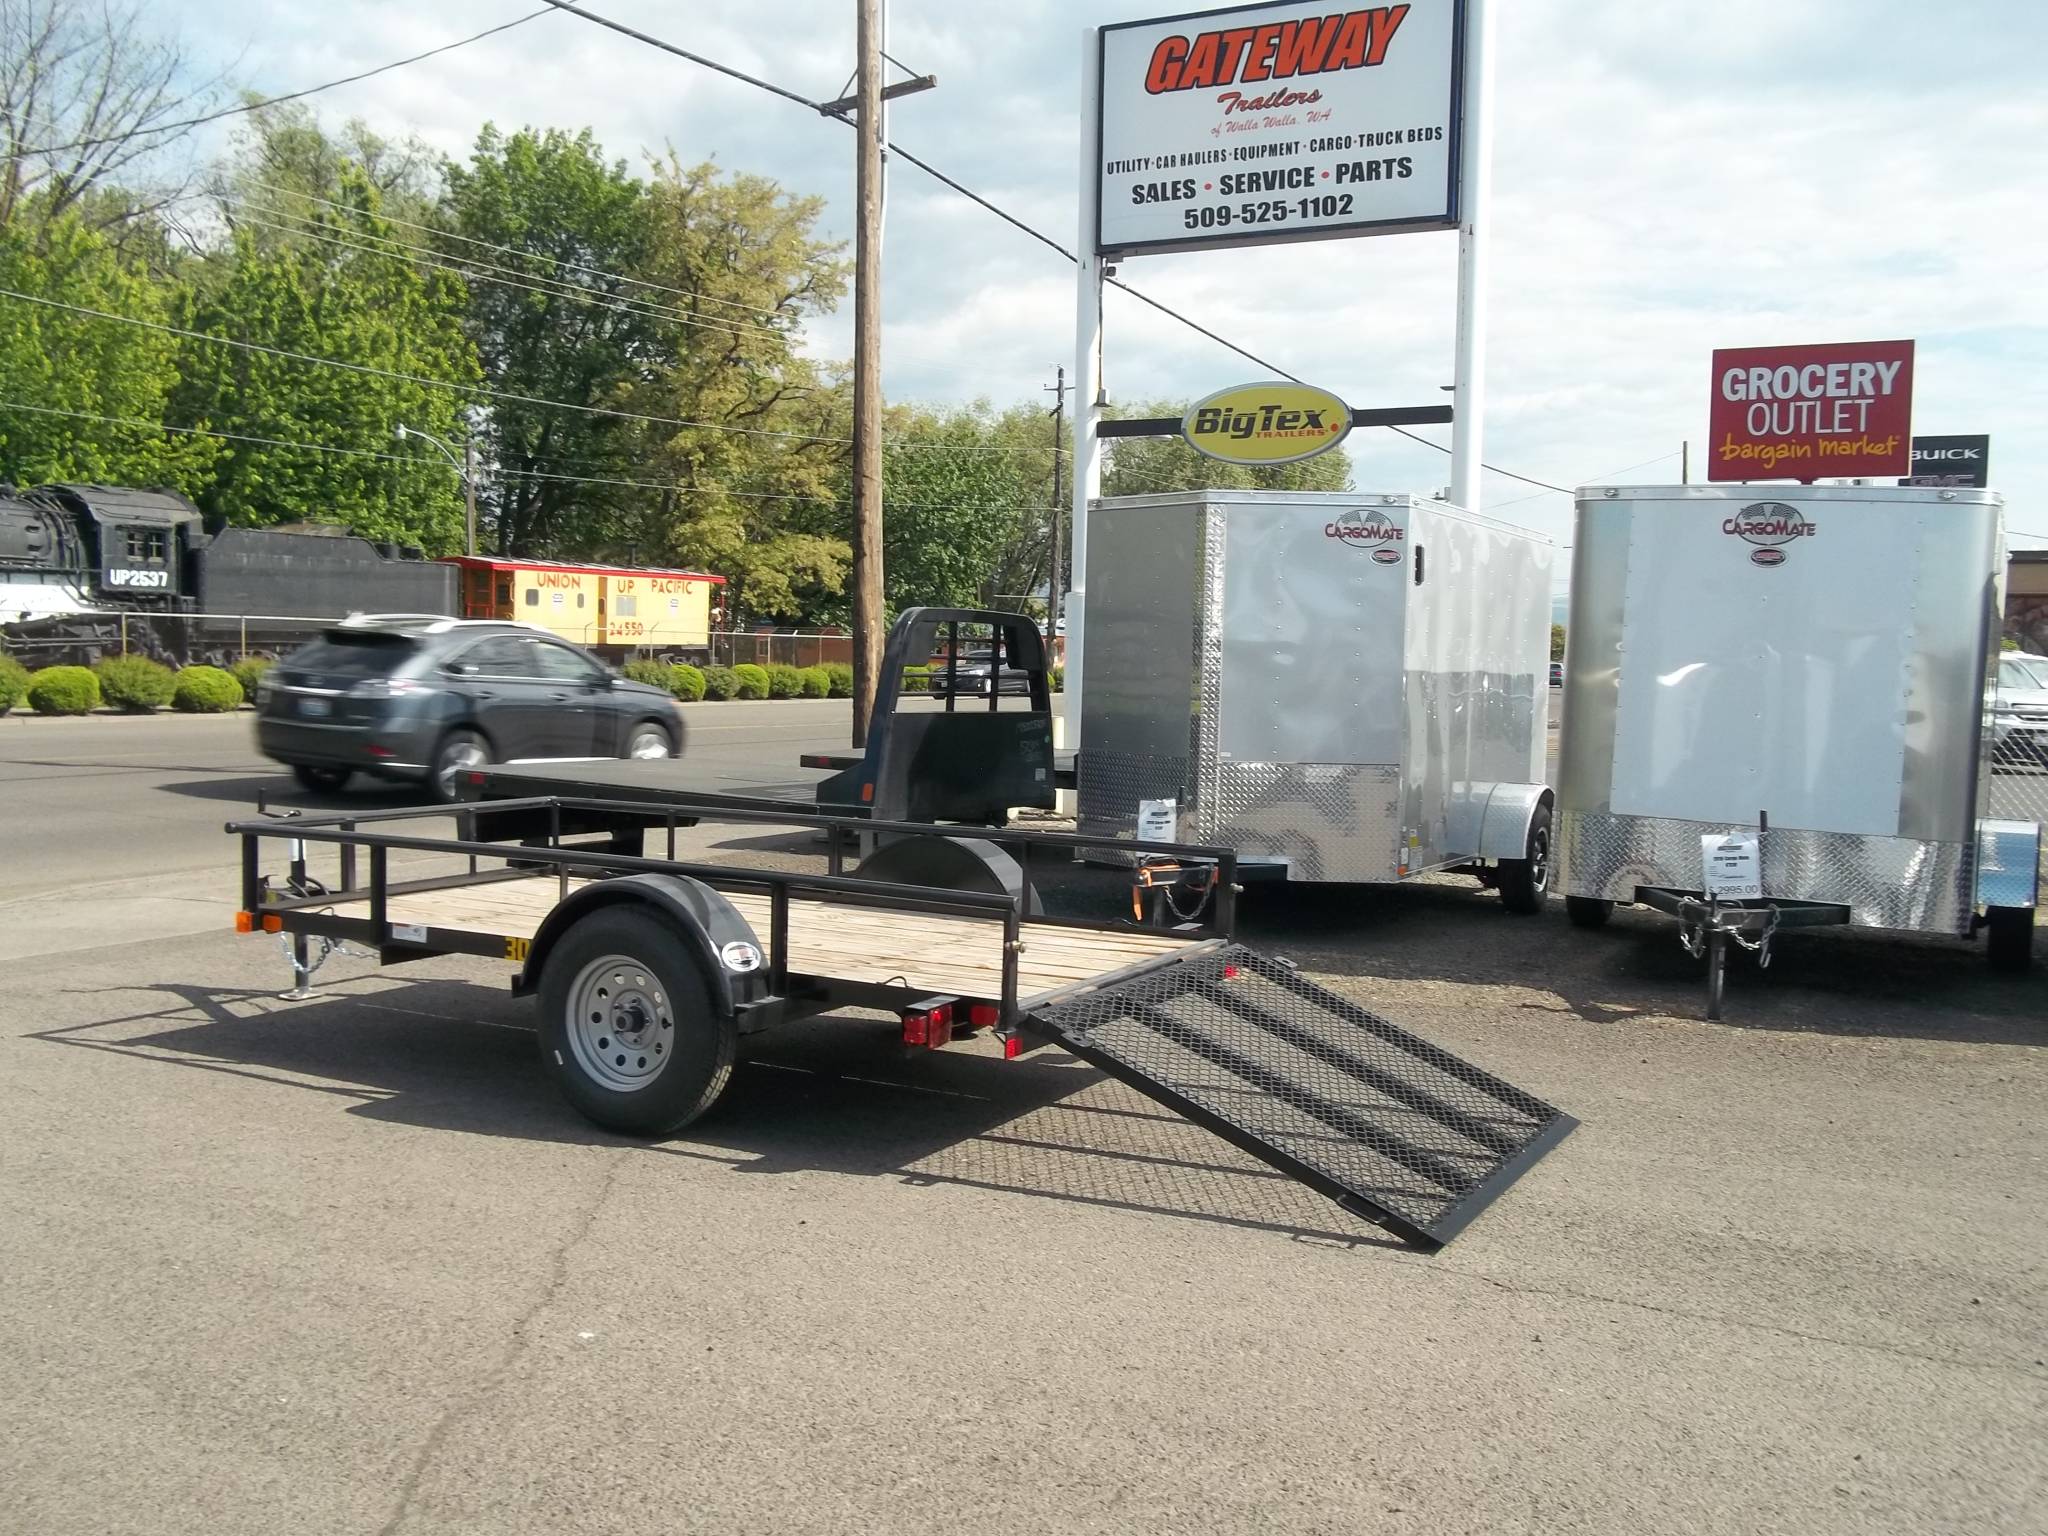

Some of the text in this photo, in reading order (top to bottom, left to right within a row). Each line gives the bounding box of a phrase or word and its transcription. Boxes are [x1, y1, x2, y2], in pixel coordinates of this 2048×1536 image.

[1144, 3, 1411, 95] GATEWAY
[1217, 87, 1322, 115] Trailers
[1210, 123, 1222, 138] of
[1226, 119, 1259, 133] Walla
[1307, 108, 1332, 123] WA
[1107, 126, 1443, 174] UTILITY CAR HAULERS EQUIPMENT CARGO TRUCK BEDS
[1132, 156, 1413, 205] SALES SERVICE PARTS
[1184, 193, 1353, 229] 509-525-1102
[1722, 360, 1902, 401] GROCERY
[1255, 429, 1325, 438] TRAILERS
[1747, 398, 1874, 436] OUTLET
[1719, 432, 1898, 469] bargain market
[1911, 448, 1980, 460] BUICK
[1910, 474, 1975, 488] GMC
[110, 568, 168, 587] UP2537
[537, 572, 693, 595] UNION UP PACIFIC
